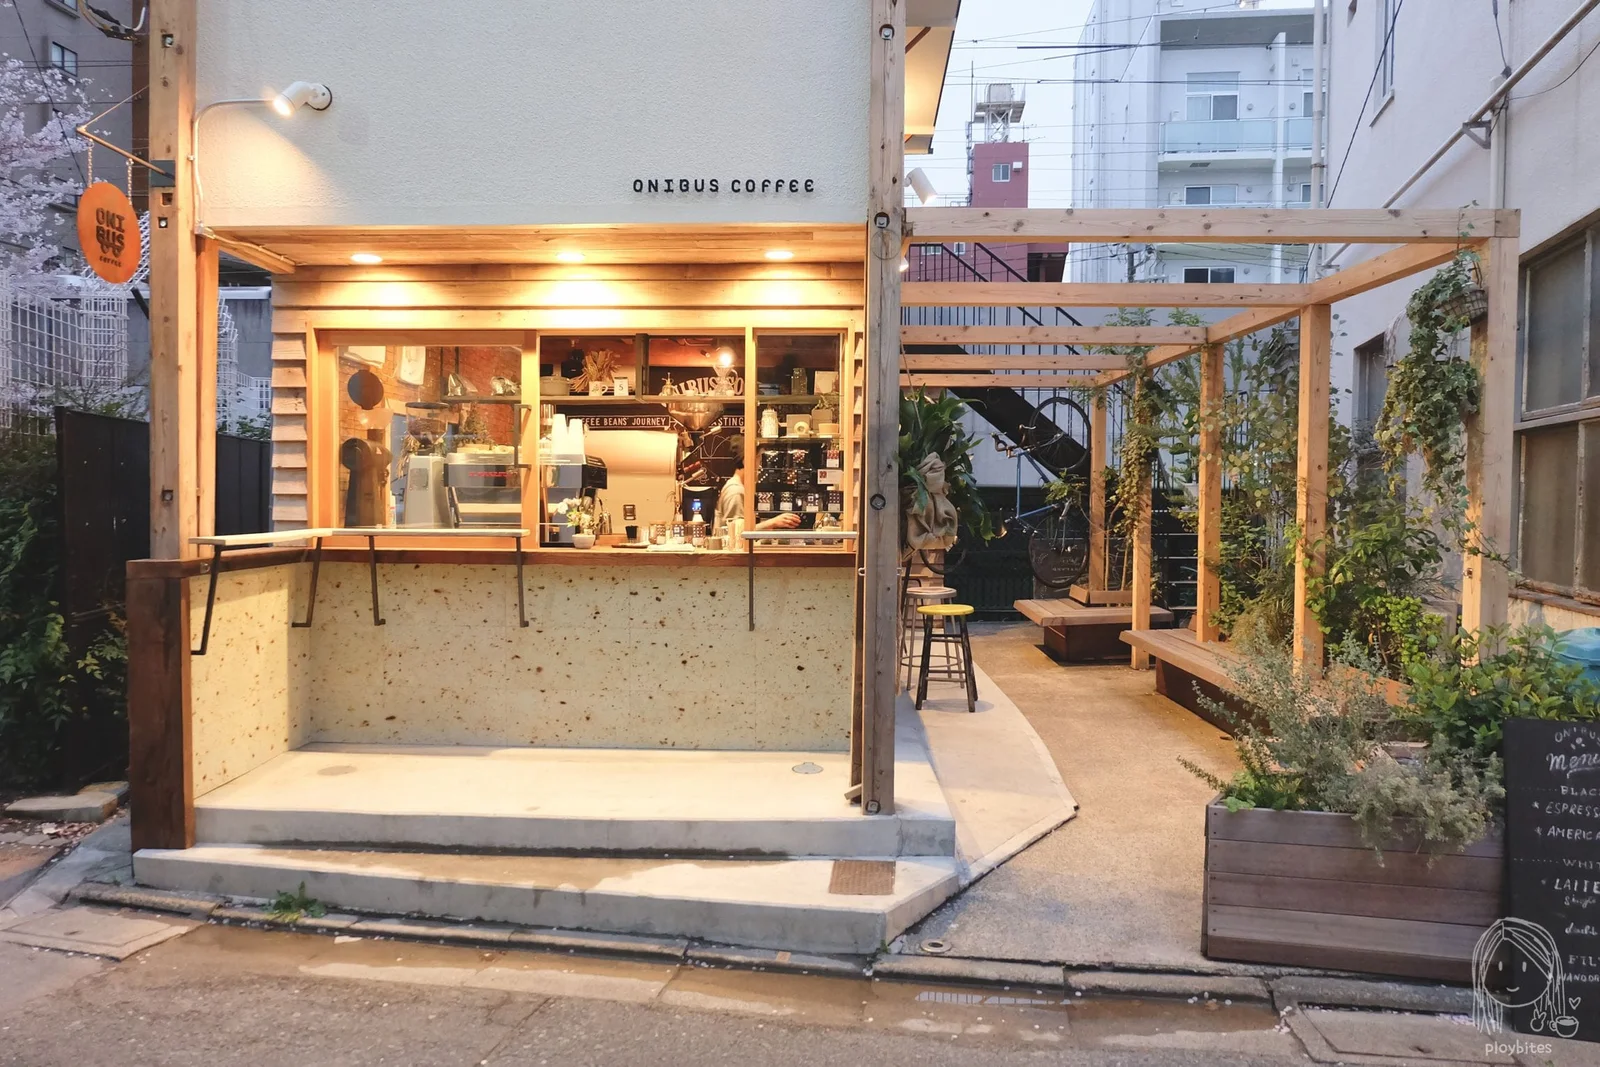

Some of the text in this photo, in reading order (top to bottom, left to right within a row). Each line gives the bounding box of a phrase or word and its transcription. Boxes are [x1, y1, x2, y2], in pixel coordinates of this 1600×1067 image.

[633, 179, 814, 193] ONIBUS COFFEE
[96, 207, 125, 233] ONI
[99, 255, 122, 267] COFFEE
[632, 417, 666, 426] JOURNEY
[1560, 785, 1600, 796] BLAC
[1545, 801, 1600, 818] ESPRESS
